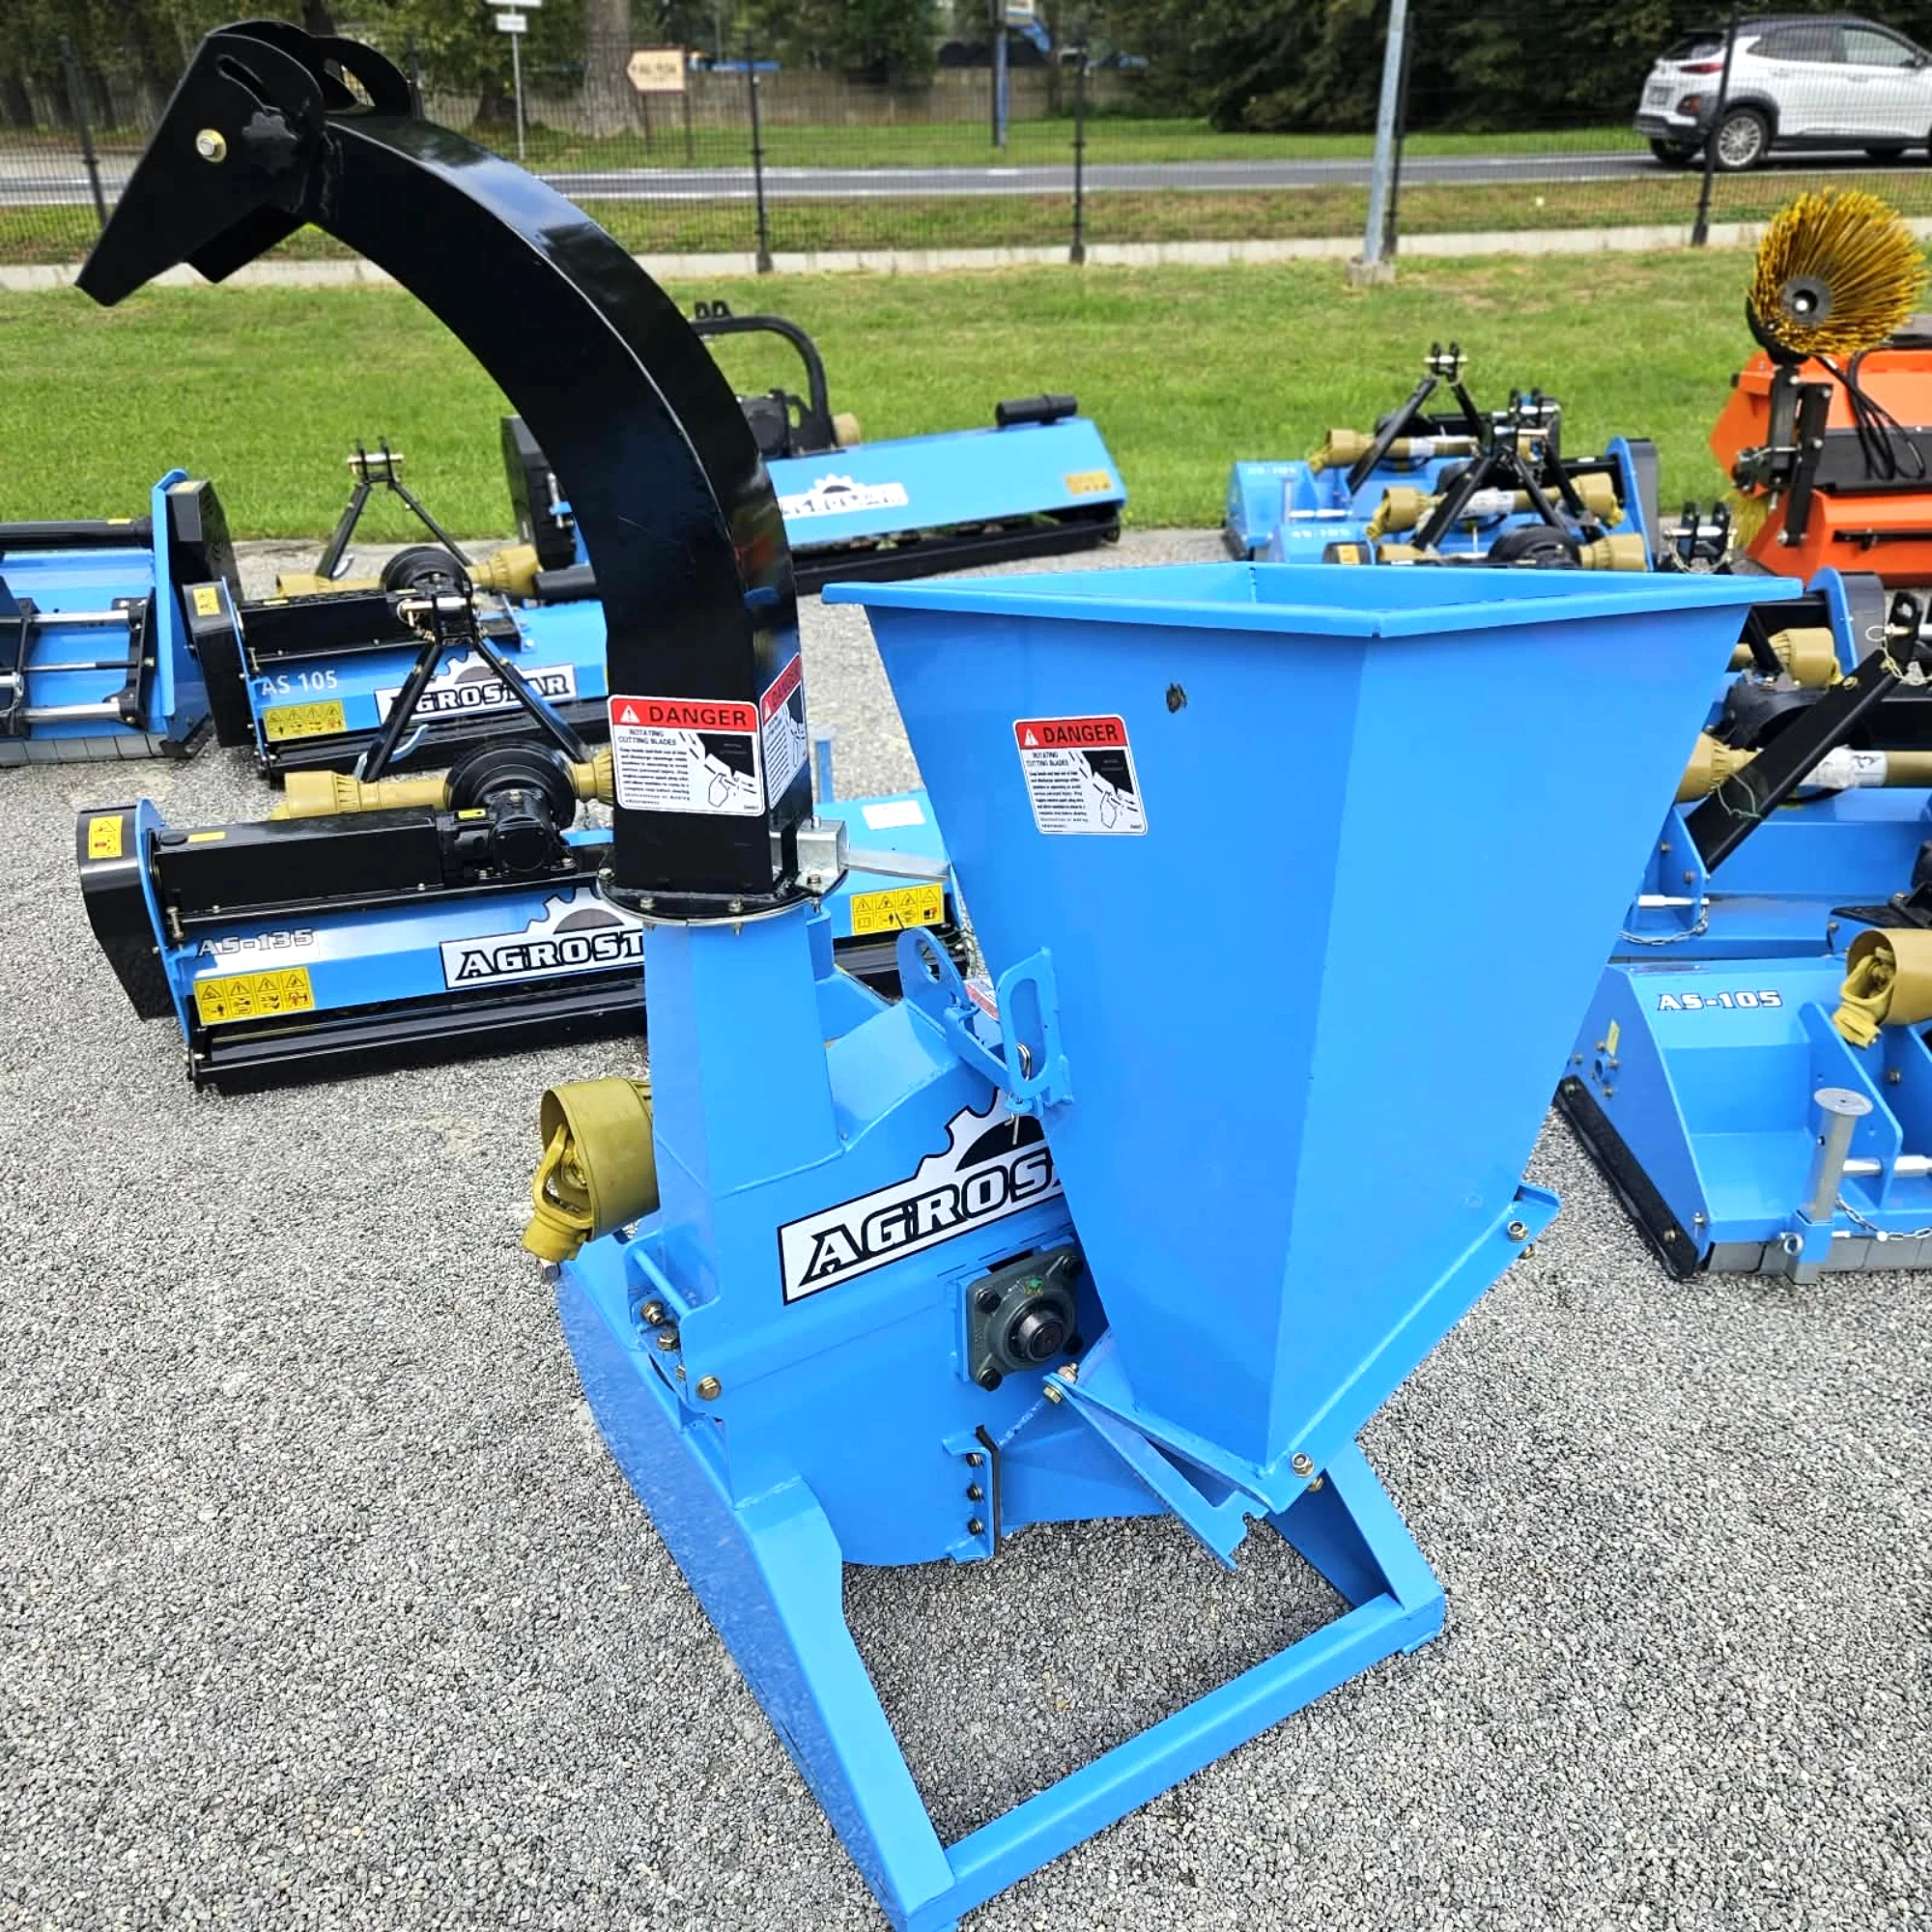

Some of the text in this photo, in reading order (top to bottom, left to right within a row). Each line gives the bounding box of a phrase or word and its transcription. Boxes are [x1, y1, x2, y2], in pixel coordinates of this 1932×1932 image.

[261, 669, 338, 696] AS 105
[389, 674, 570, 713] GROSR
[649, 706, 747, 725] DANGER
[1042, 724, 1119, 744] DANGER
[195, 927, 315, 958] AS-135
[455, 928, 643, 980] AGROST
[1657, 990, 1783, 1010] AS-105
[798, 1147, 1060, 1287] AGROS
